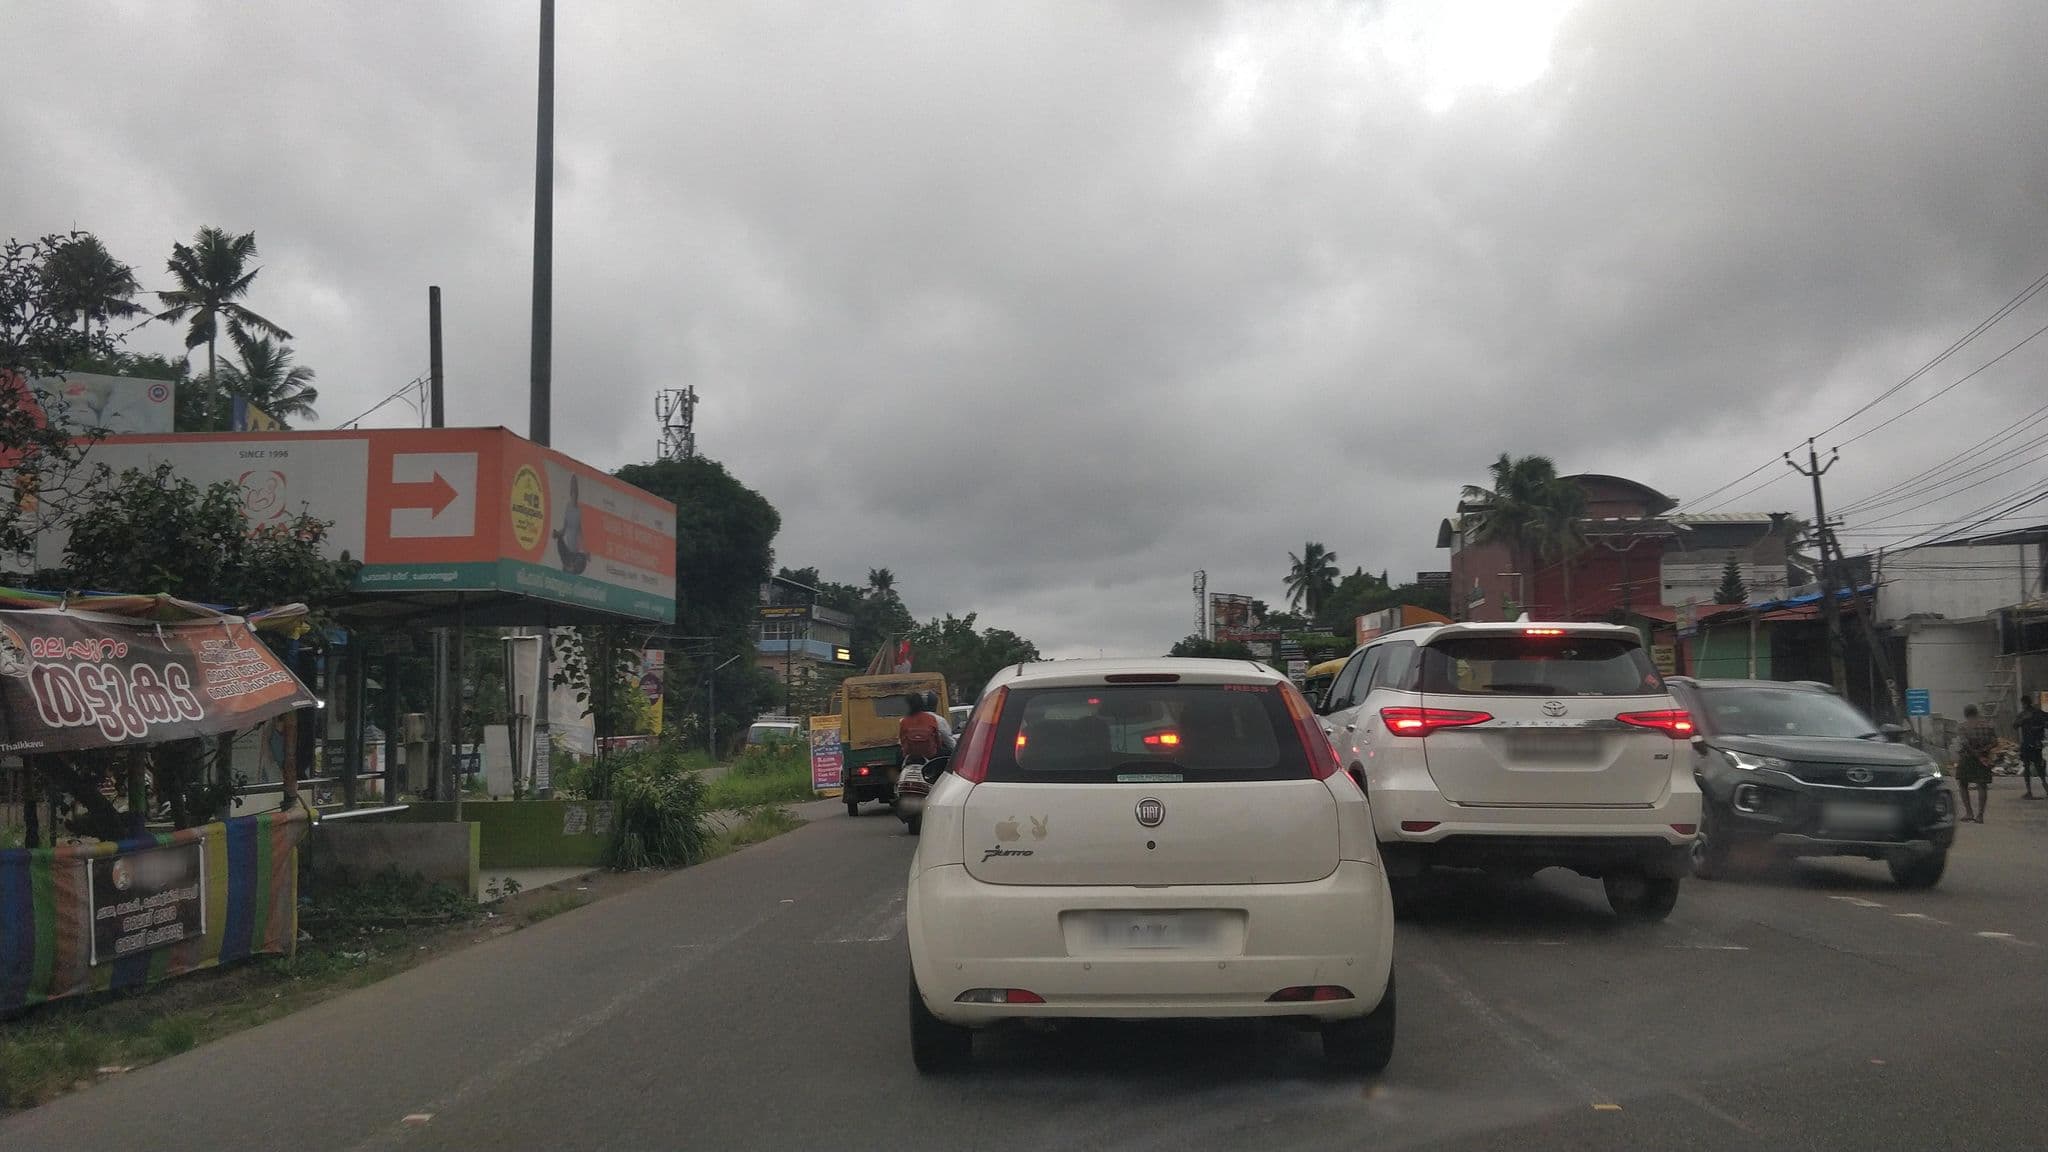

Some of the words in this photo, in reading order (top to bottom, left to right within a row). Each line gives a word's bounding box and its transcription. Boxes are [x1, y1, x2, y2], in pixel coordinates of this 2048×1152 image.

[239, 450, 265, 459] SINCE
[31, 636, 129, 663] മലപ്പുറം
[28, 662, 205, 742] തട്ടുകട
[1142, 805, 1159, 819] FIAT
